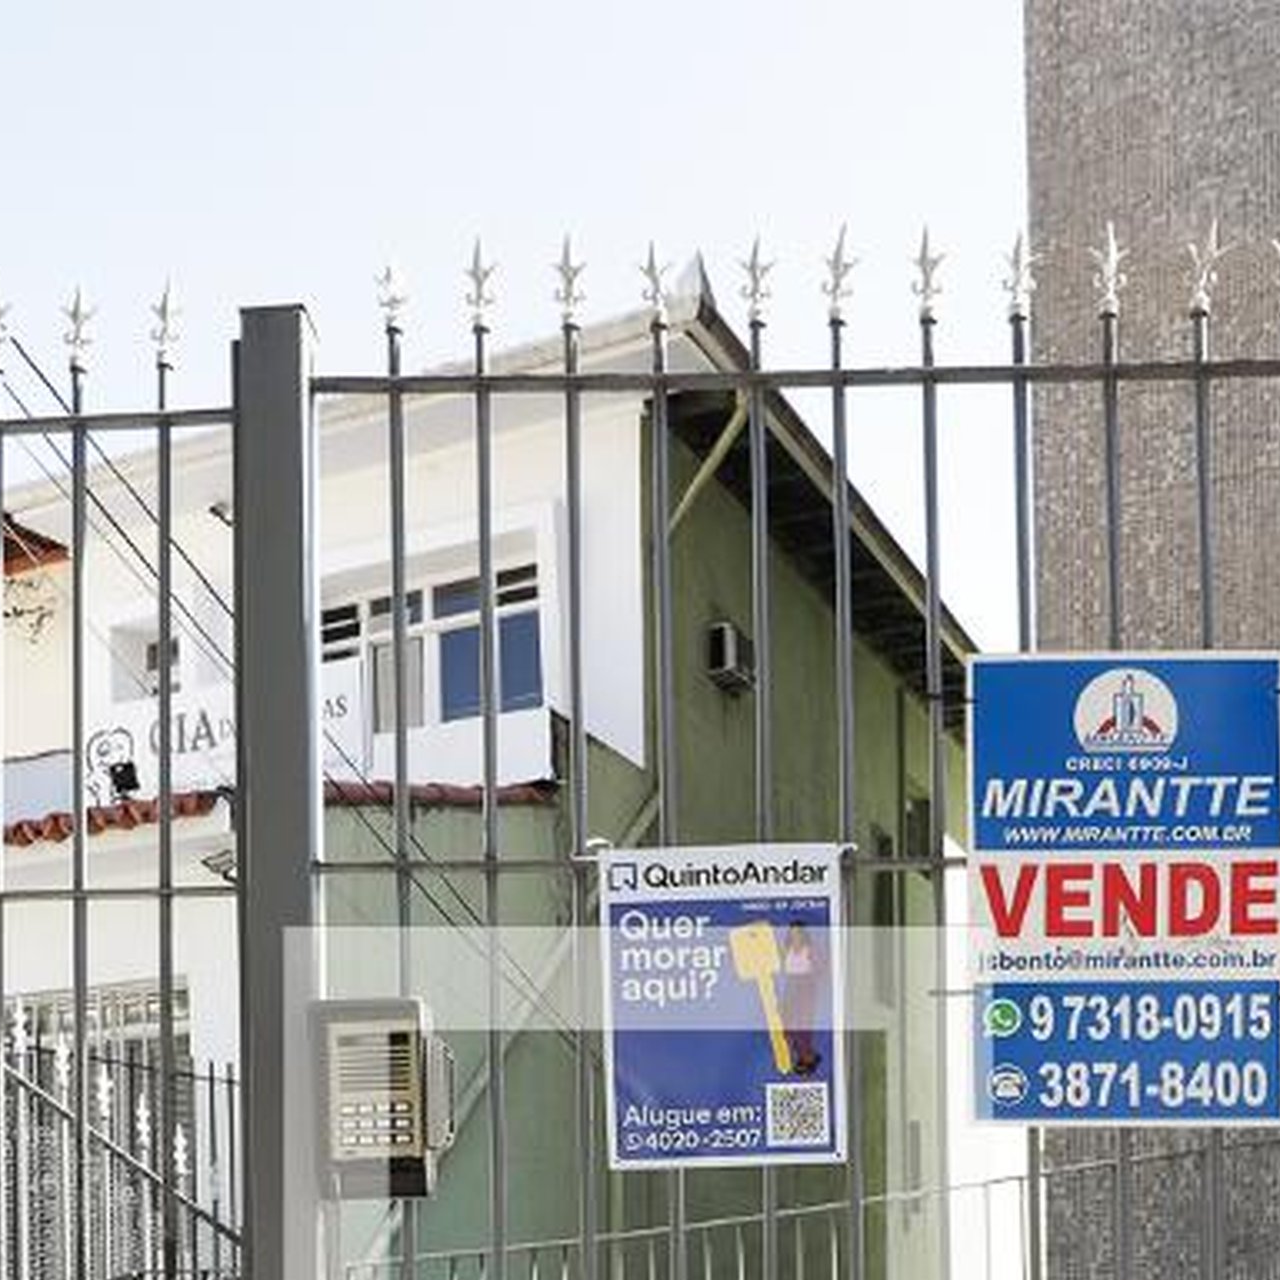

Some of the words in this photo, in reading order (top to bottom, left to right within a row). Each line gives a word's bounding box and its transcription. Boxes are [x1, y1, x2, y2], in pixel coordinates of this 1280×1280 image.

[982, 775, 1275, 819] MIRANTTE
[1005, 825, 1252, 843] WWW.MIRANTTE.COM.BR
[643, 860, 828, 889] QuintoAndar
[980, 860, 1279, 938] VENDE
[620, 910, 710, 943] Quer
[621, 945, 726, 971] morar
[622, 970, 718, 1008] aqui?
[1030, 994, 1054, 1041] 9
[1062, 993, 1271, 1041] 7318-0915
[1038, 1061, 1268, 1108] 3871-8400
[623, 1105, 711, 1131] Alugue
[716, 1105, 762, 1125] em:
[646, 1129, 762, 1151] 4020-2507
